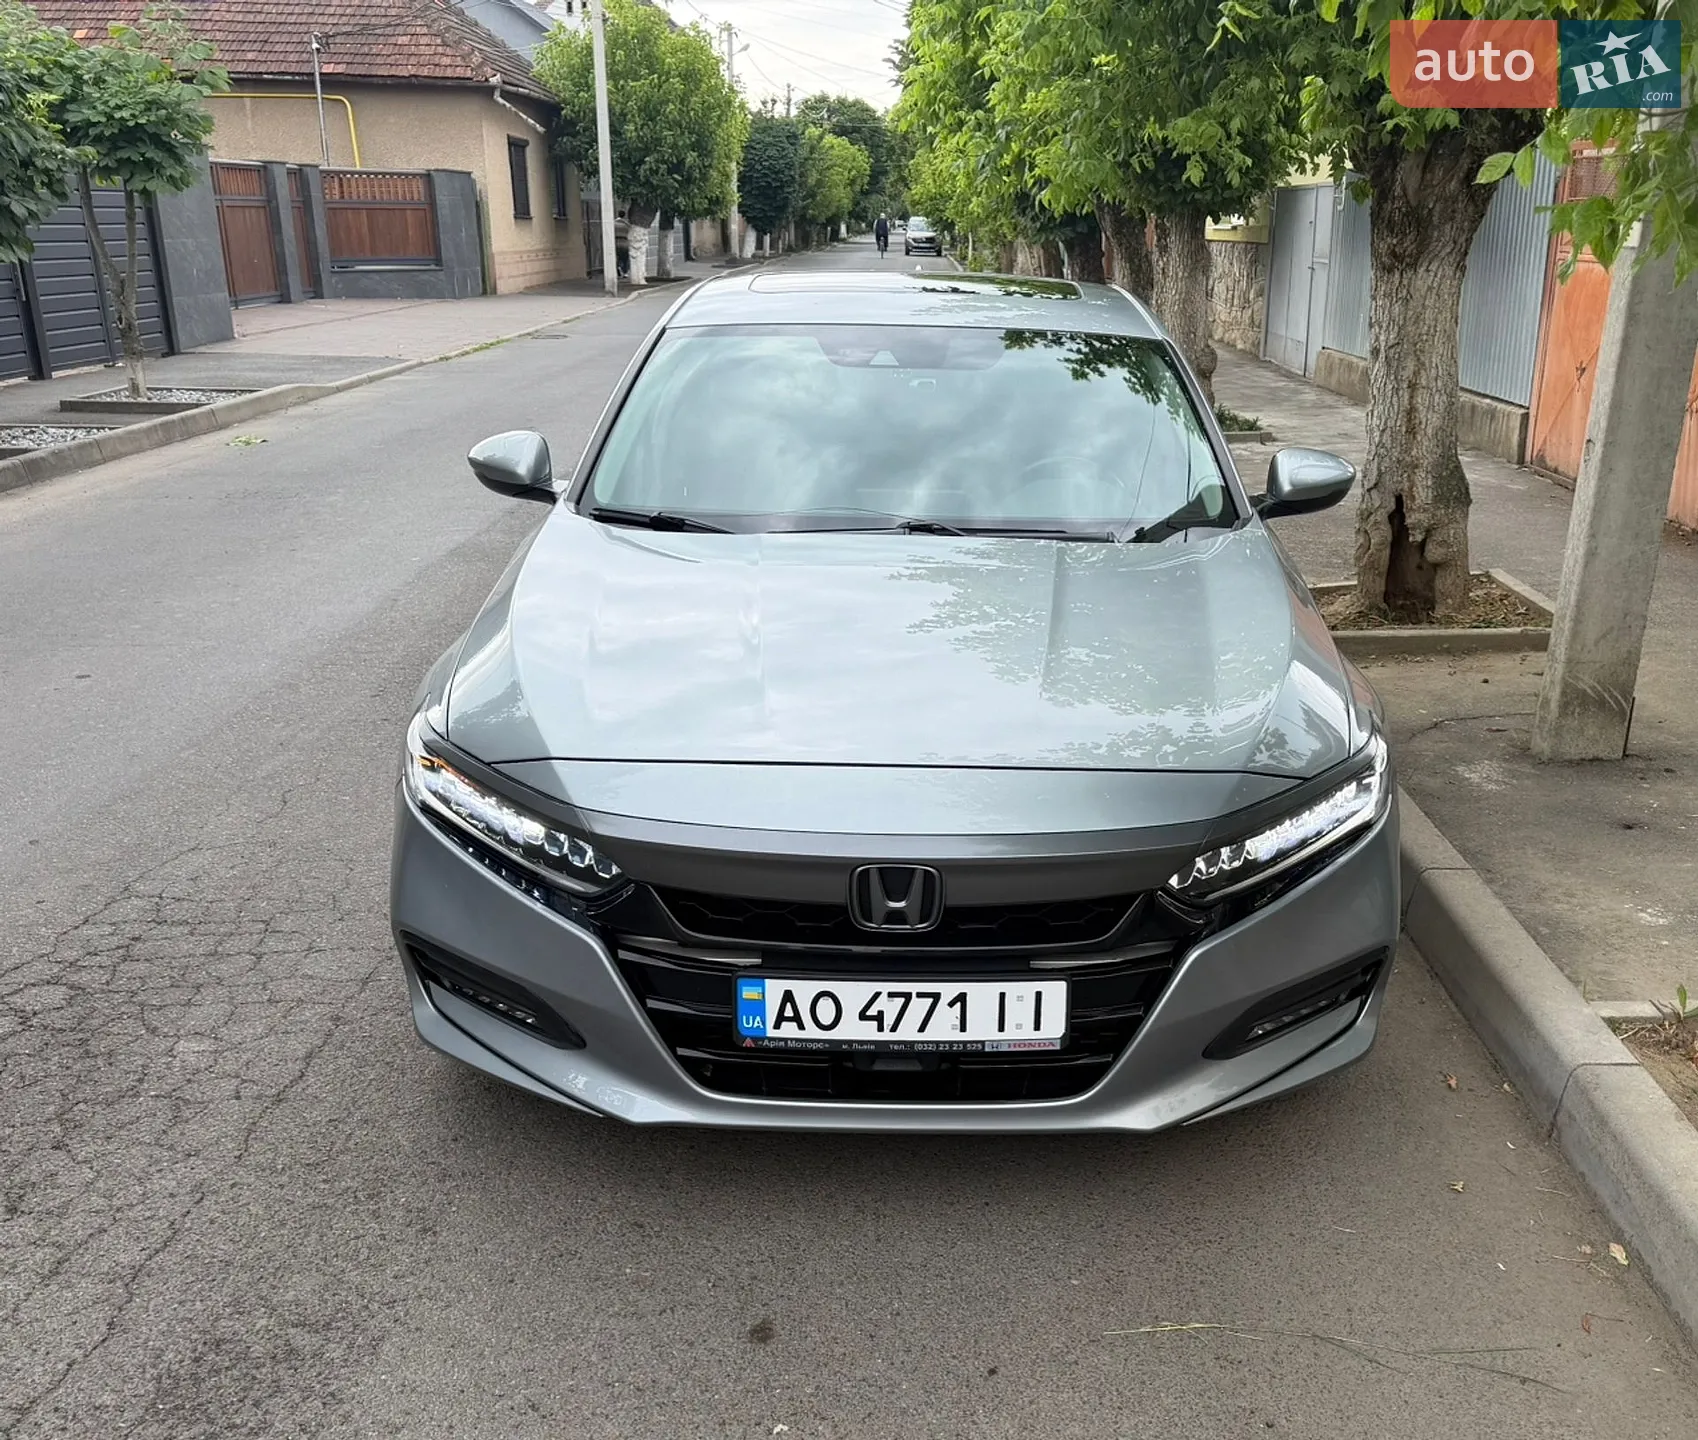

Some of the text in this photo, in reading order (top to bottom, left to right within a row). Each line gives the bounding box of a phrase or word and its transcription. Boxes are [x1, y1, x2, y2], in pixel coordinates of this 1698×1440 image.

[772, 988, 843, 1032] AO
[858, 990, 968, 1033] 4771
[742, 1017, 764, 1029] UA
[914, 1042, 937, 1051] (032)
[939, 1043, 950, 1051] 23
[952, 1043, 963, 1051] 23
[1007, 1041, 1056, 1049] HONDA
